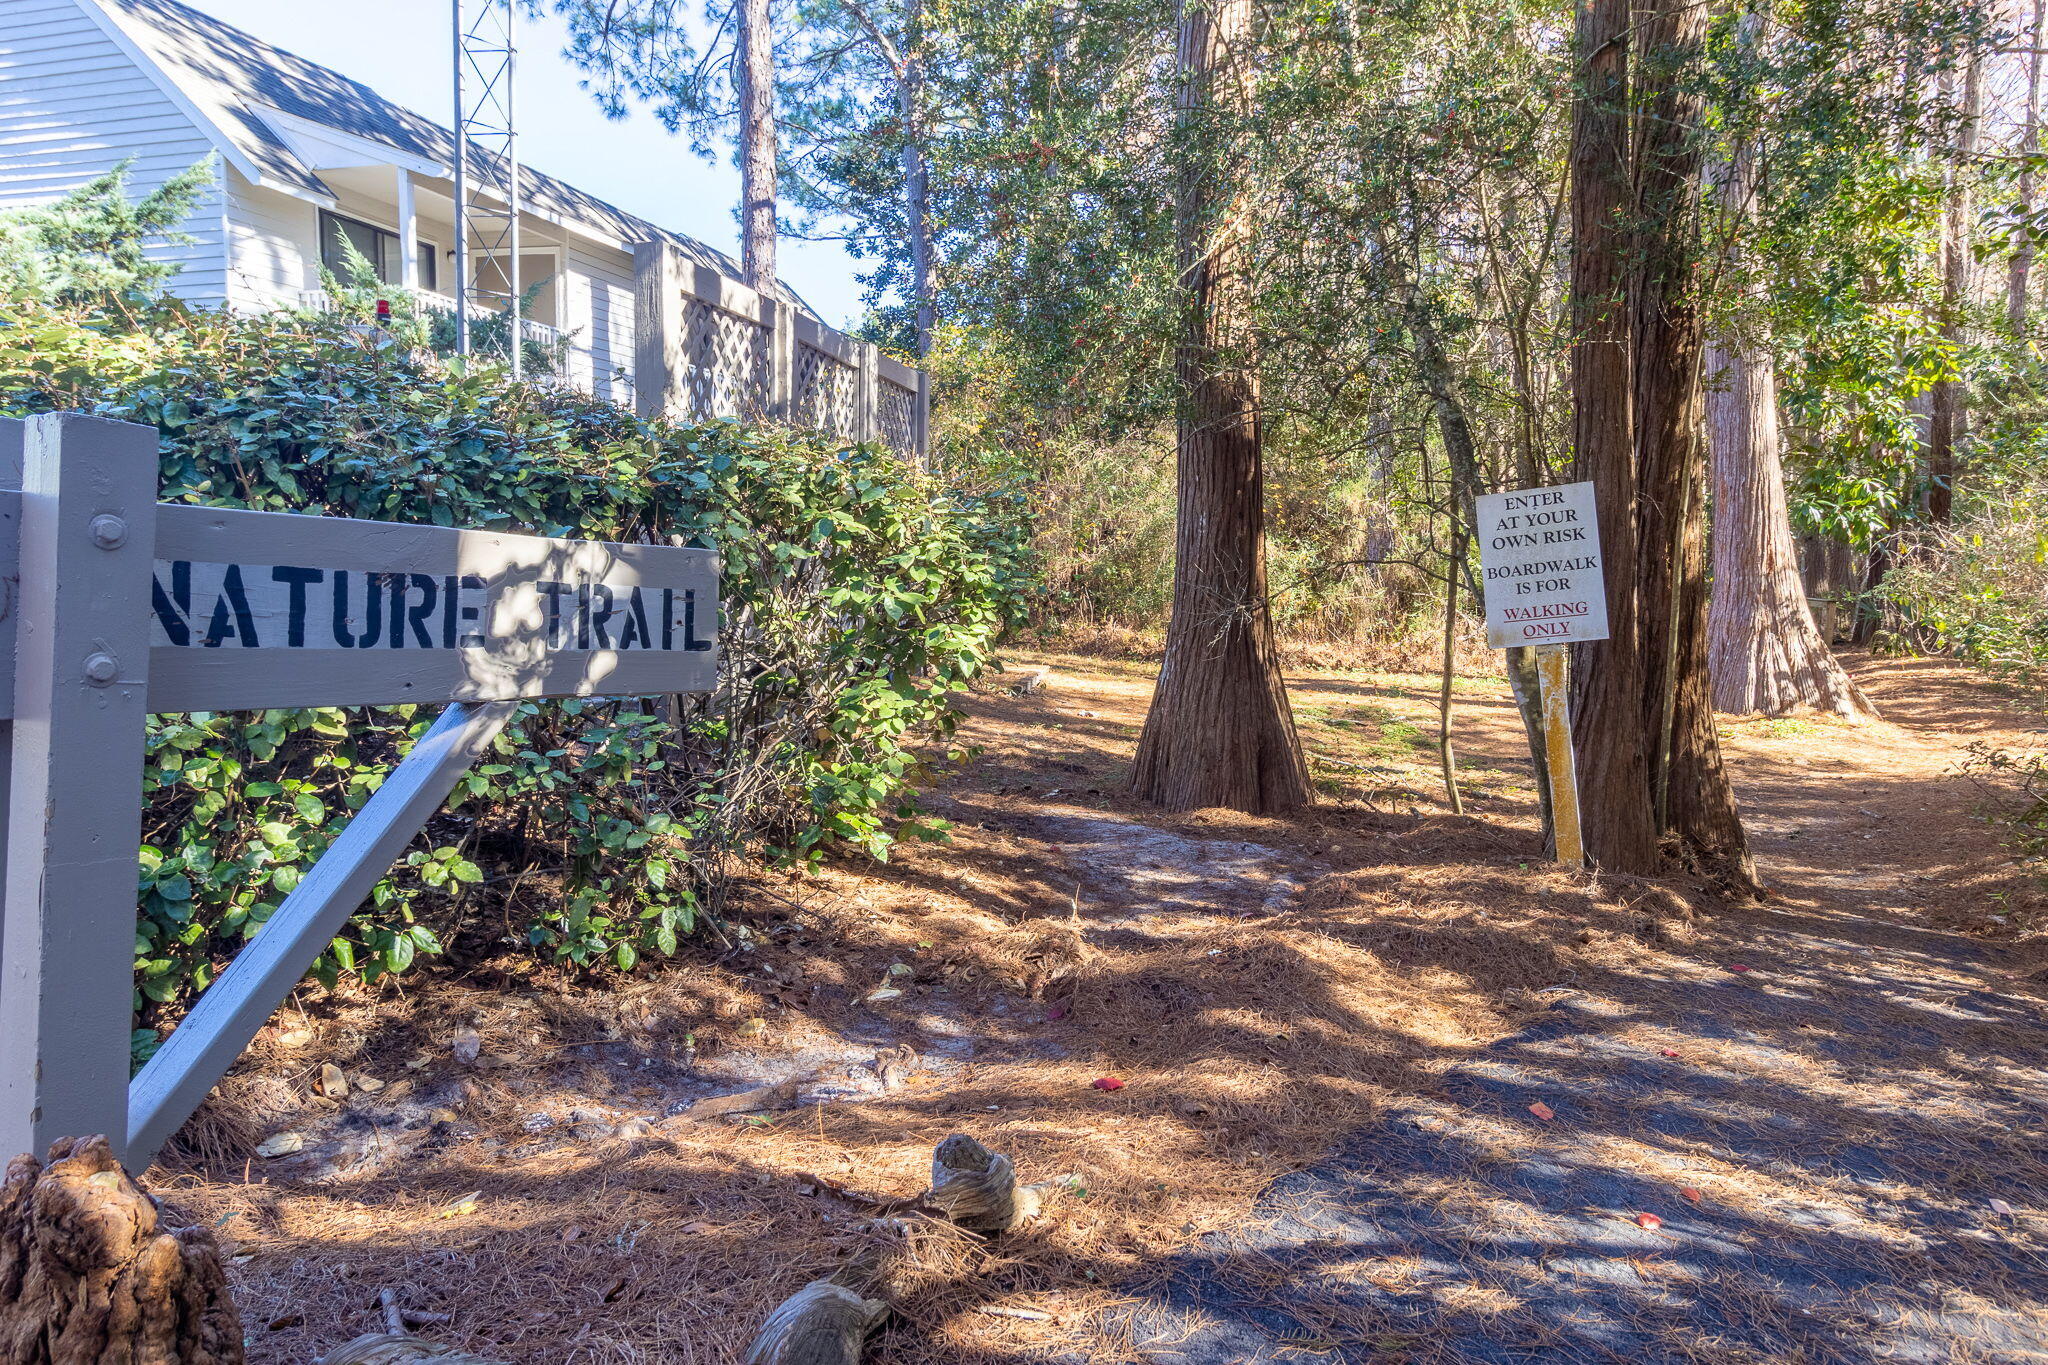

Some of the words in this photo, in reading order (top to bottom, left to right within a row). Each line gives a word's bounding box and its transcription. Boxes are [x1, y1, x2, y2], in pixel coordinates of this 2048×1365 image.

[1504, 491, 1565, 511] ENTER
[1496, 515, 1520, 531] AT
[1525, 509, 1579, 527] YOUR
[1492, 532, 1538, 550] OWN
[1543, 527, 1586, 544] RISK
[1487, 556, 1598, 580] BOARDWALK
[1516, 582, 1531, 595] IS
[1536, 578, 1571, 593] FOR
[152, 560, 488, 650] NATURE
[536, 580, 713, 652] TRAIL
[1503, 601, 1588, 621] WALKING
[1523, 621, 1571, 637] ONLY
